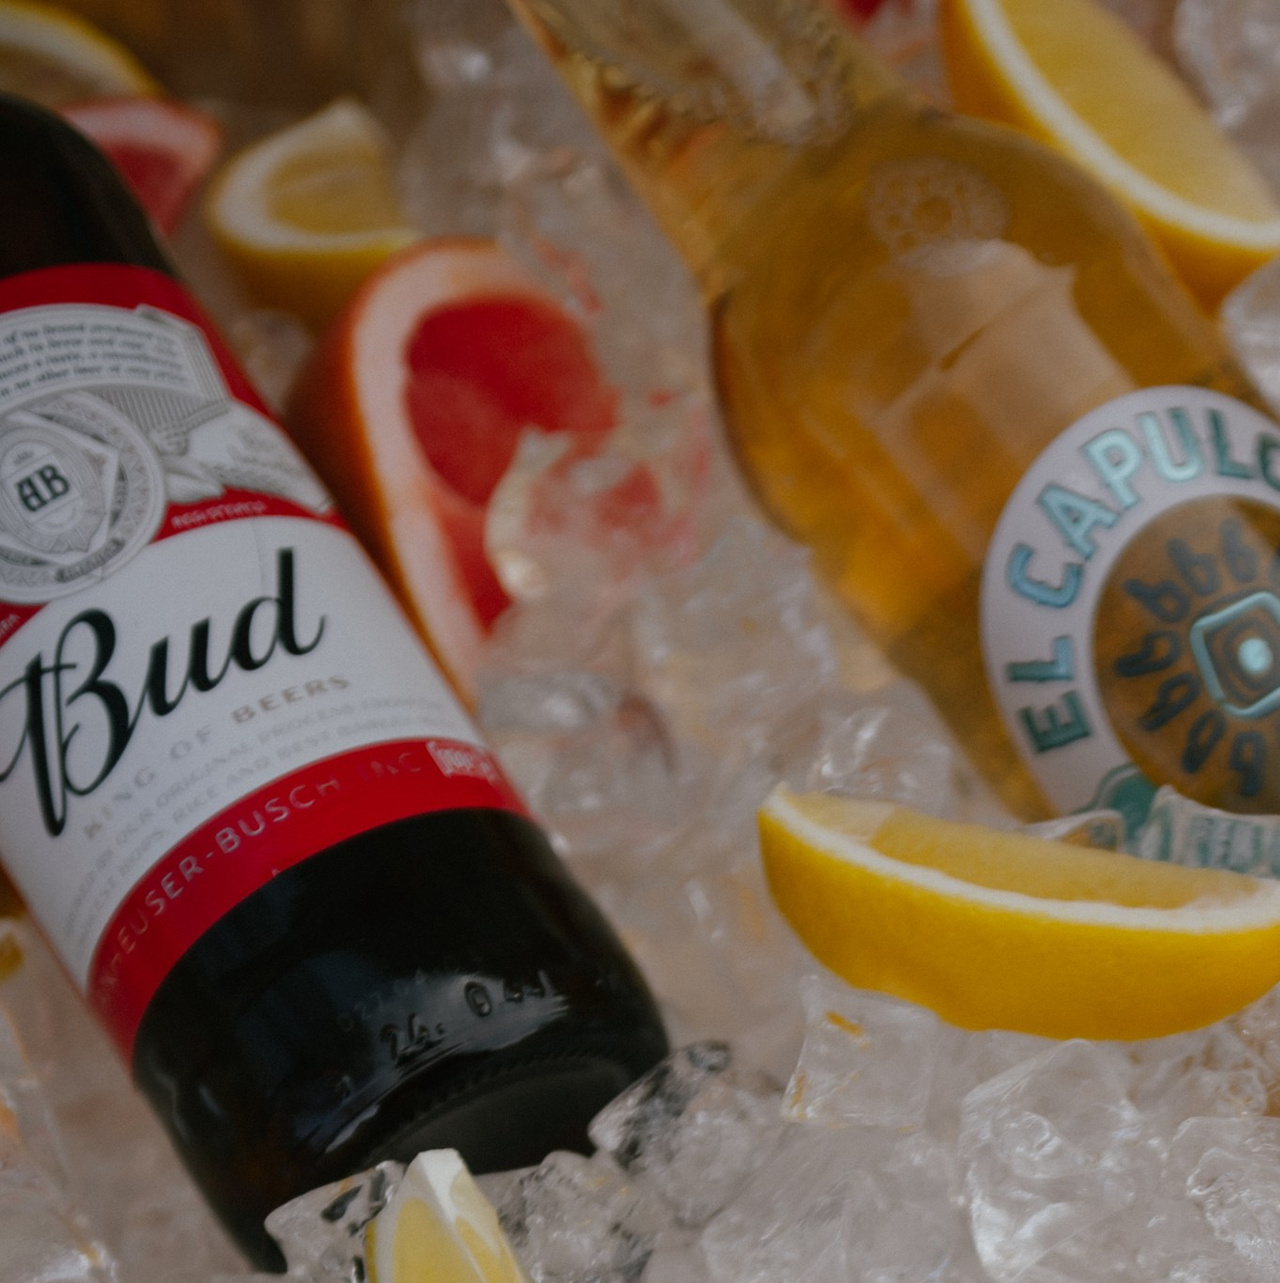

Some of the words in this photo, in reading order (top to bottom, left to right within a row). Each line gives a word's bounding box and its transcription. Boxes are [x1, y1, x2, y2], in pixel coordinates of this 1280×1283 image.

[0, 547, 326, 837] Bud
[231, 673, 352, 726] BEERS
[1005, 634, 1092, 754] EL
